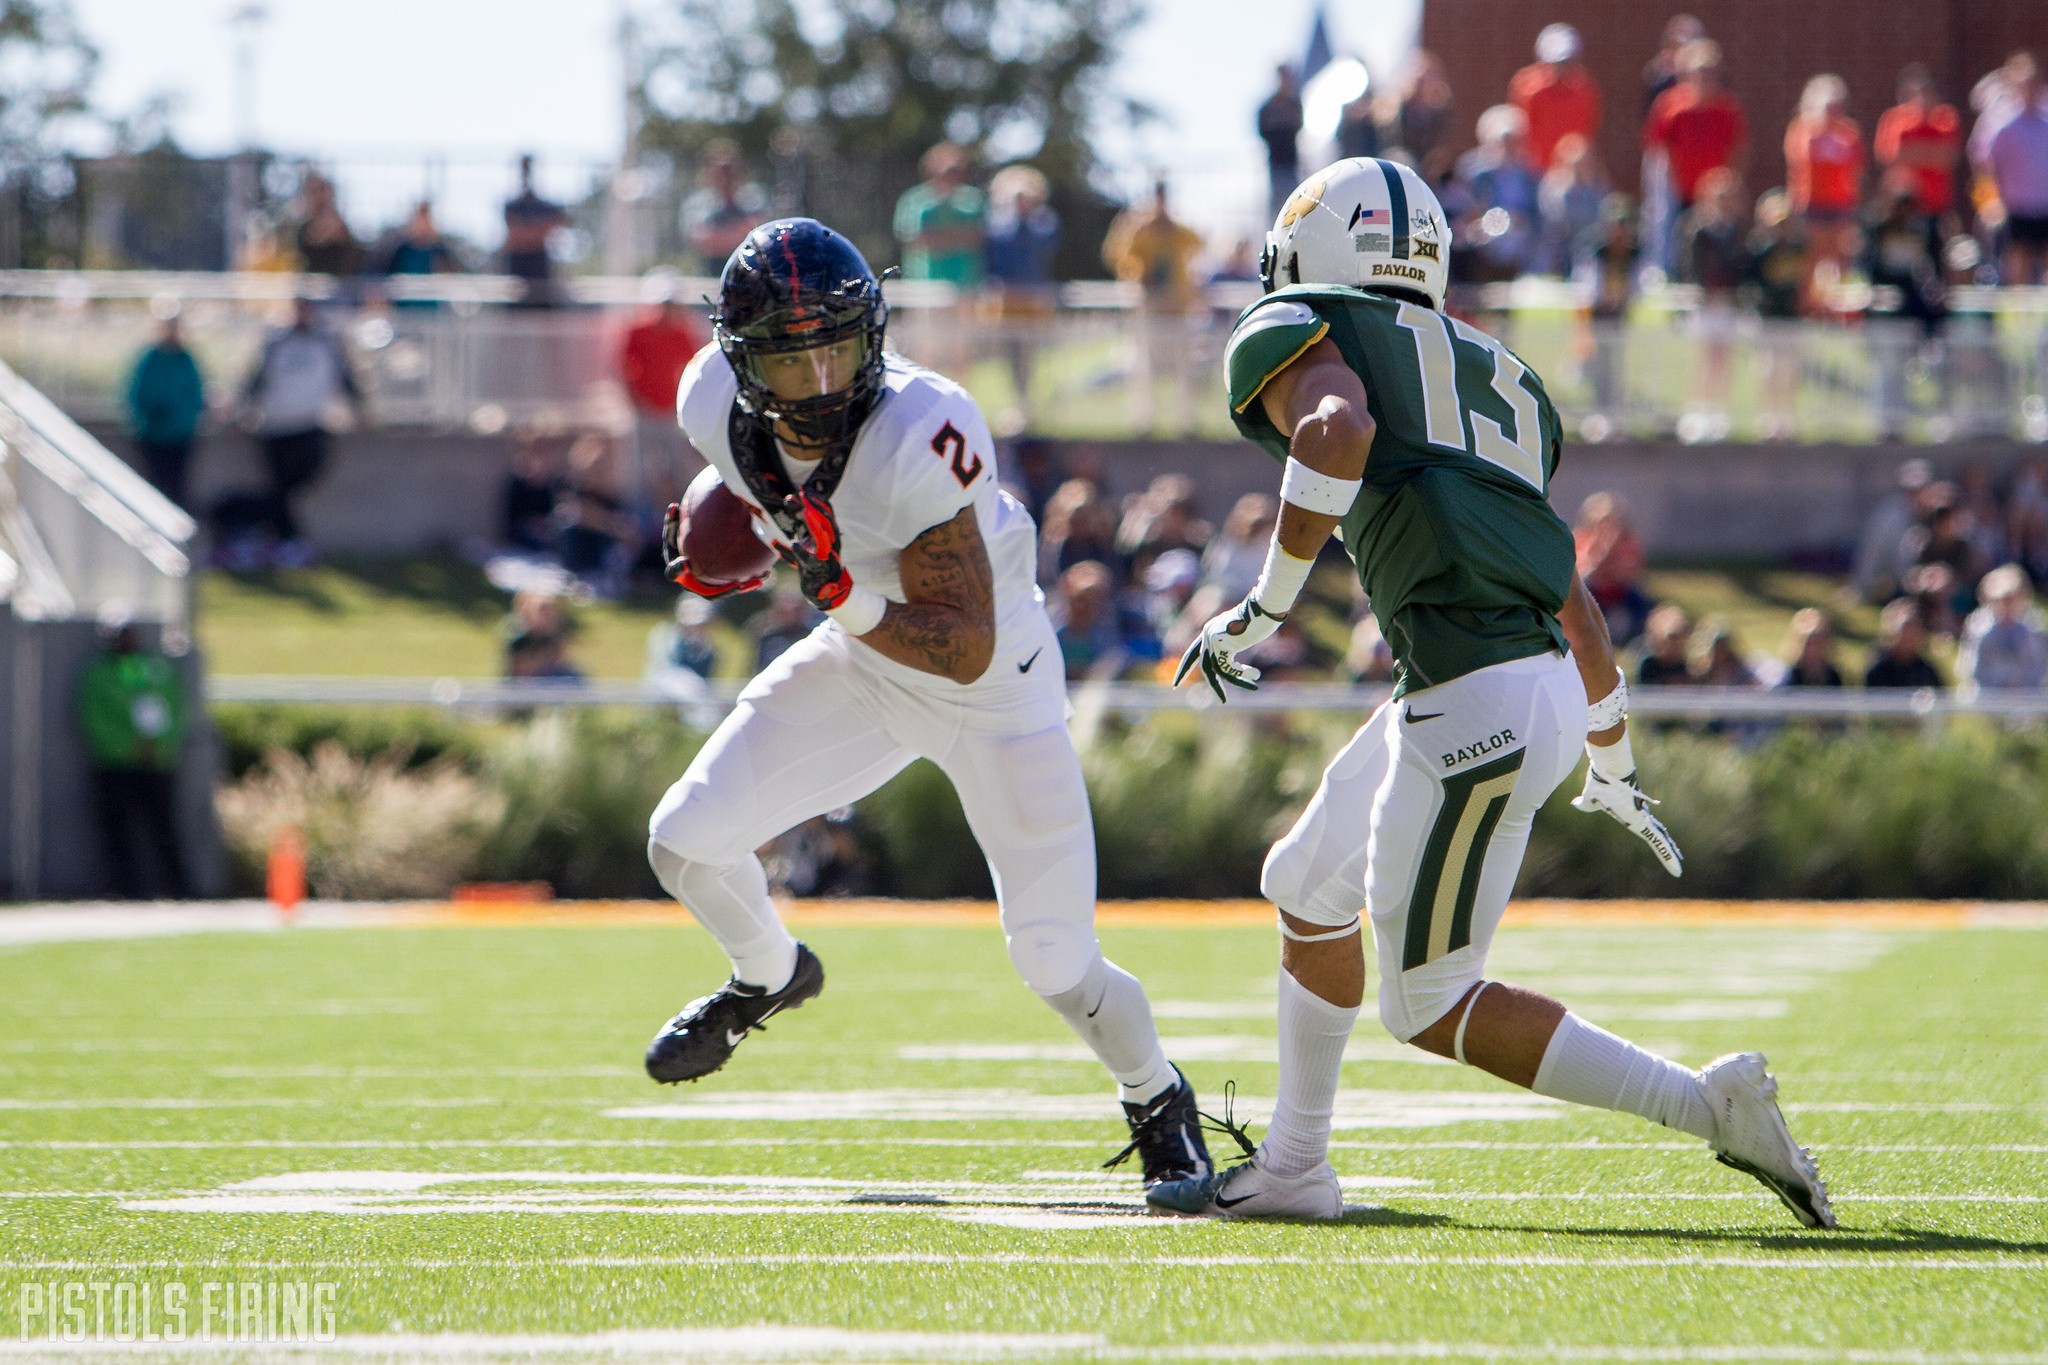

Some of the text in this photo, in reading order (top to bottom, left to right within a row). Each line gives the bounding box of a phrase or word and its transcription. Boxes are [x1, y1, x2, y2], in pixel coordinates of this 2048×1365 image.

[1372, 263, 1426, 283] BAYLOR
[1396, 300, 1543, 493] 13
[930, 418, 983, 489] 2
[1441, 729, 1516, 768] BAYLOR
[1640, 827, 1672, 862] BAYLOR
